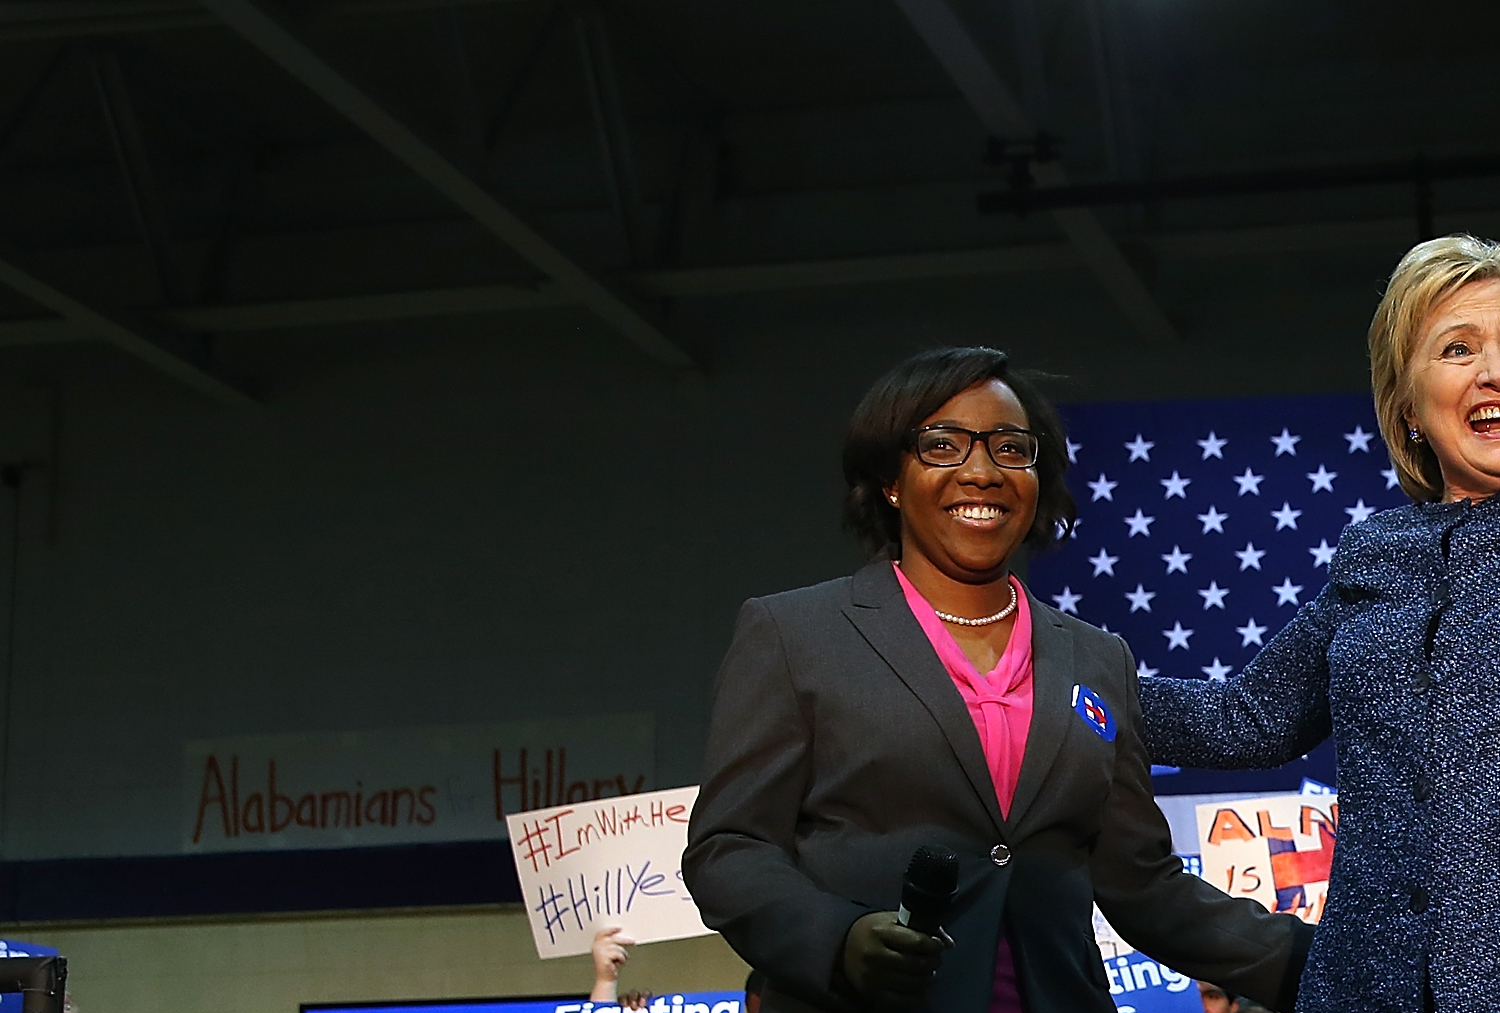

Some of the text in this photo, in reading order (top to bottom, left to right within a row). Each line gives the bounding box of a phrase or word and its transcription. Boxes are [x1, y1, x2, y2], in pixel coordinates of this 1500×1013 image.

[193, 754, 438, 844] Alabamians
[517, 800, 689, 873] #ImWithHe
[1103, 956, 1191, 993] ting
